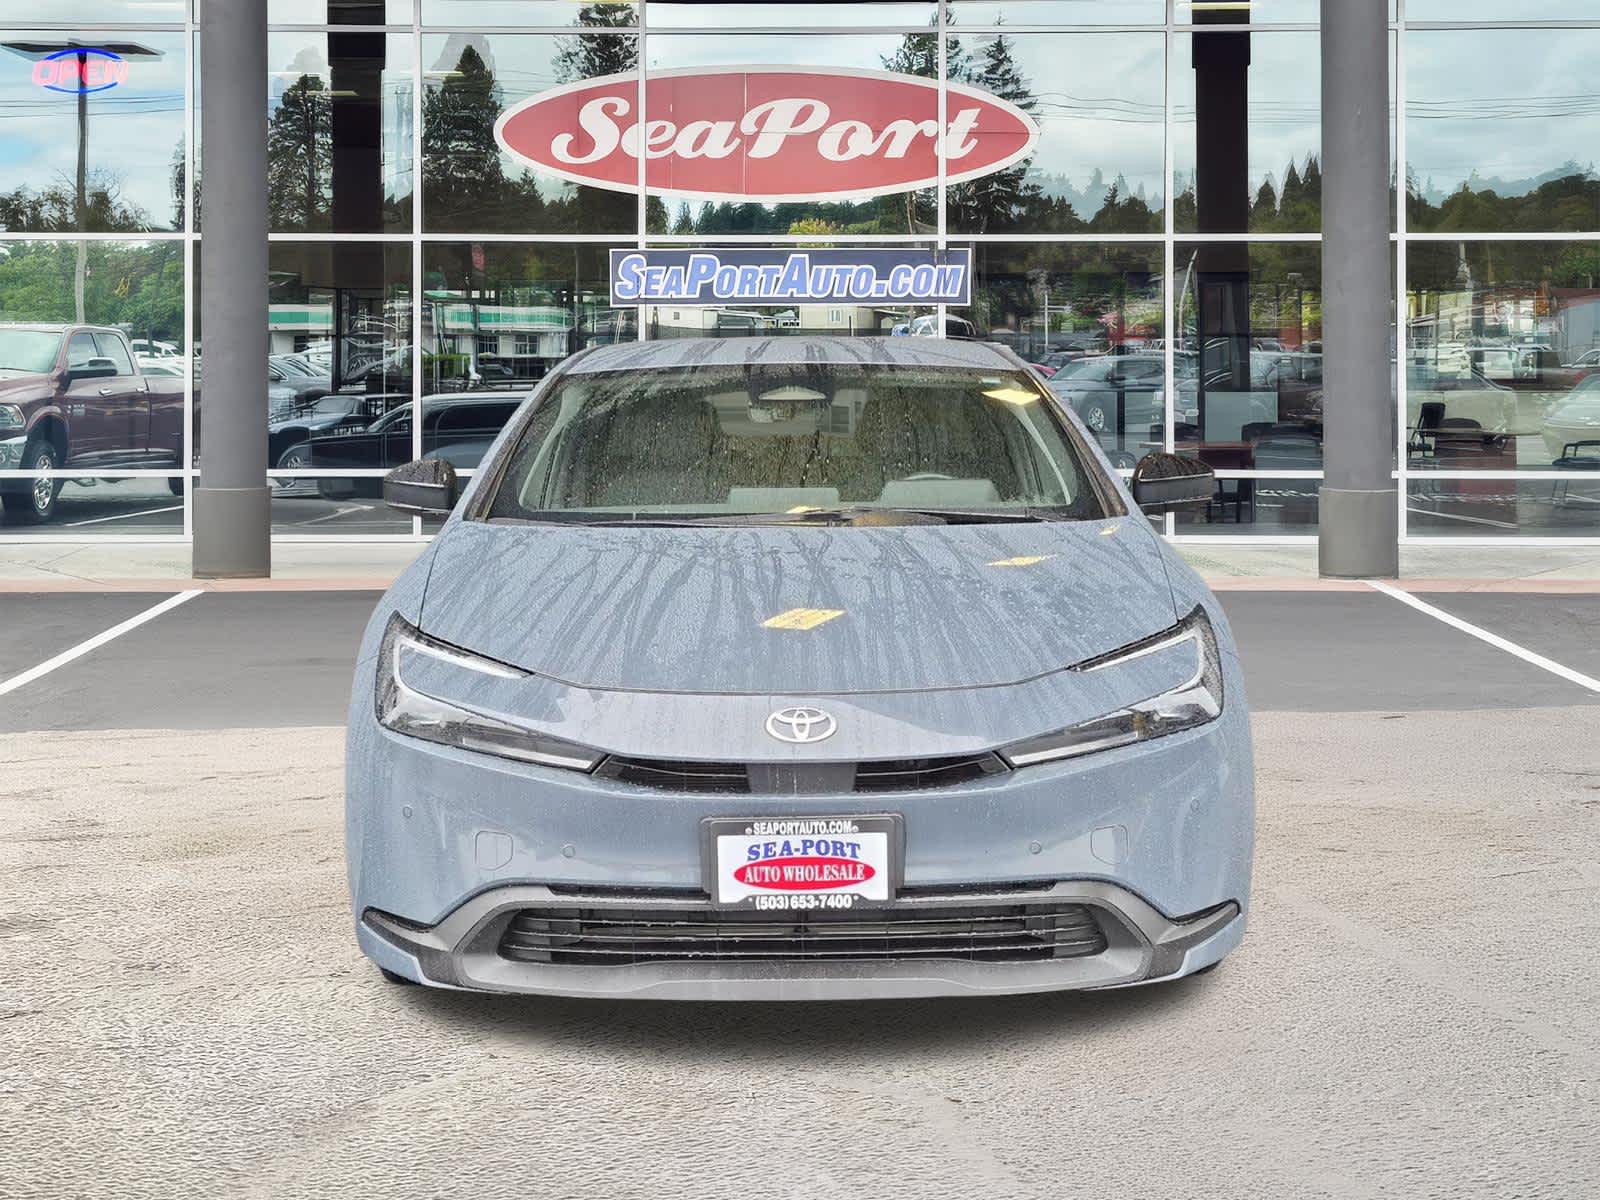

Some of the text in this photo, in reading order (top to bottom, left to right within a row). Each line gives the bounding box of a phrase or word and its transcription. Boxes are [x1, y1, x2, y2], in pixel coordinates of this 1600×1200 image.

[32, 60, 128, 86] OPEN
[550, 95, 982, 165] SeaPort
[753, 820, 852, 836] SEAPORTAUTO.COM
[747, 839, 860, 861] SEA-PORT
[744, 864, 865, 883] AUTO WHOLESALE
[755, 894, 852, 910] (503) 653-7400
